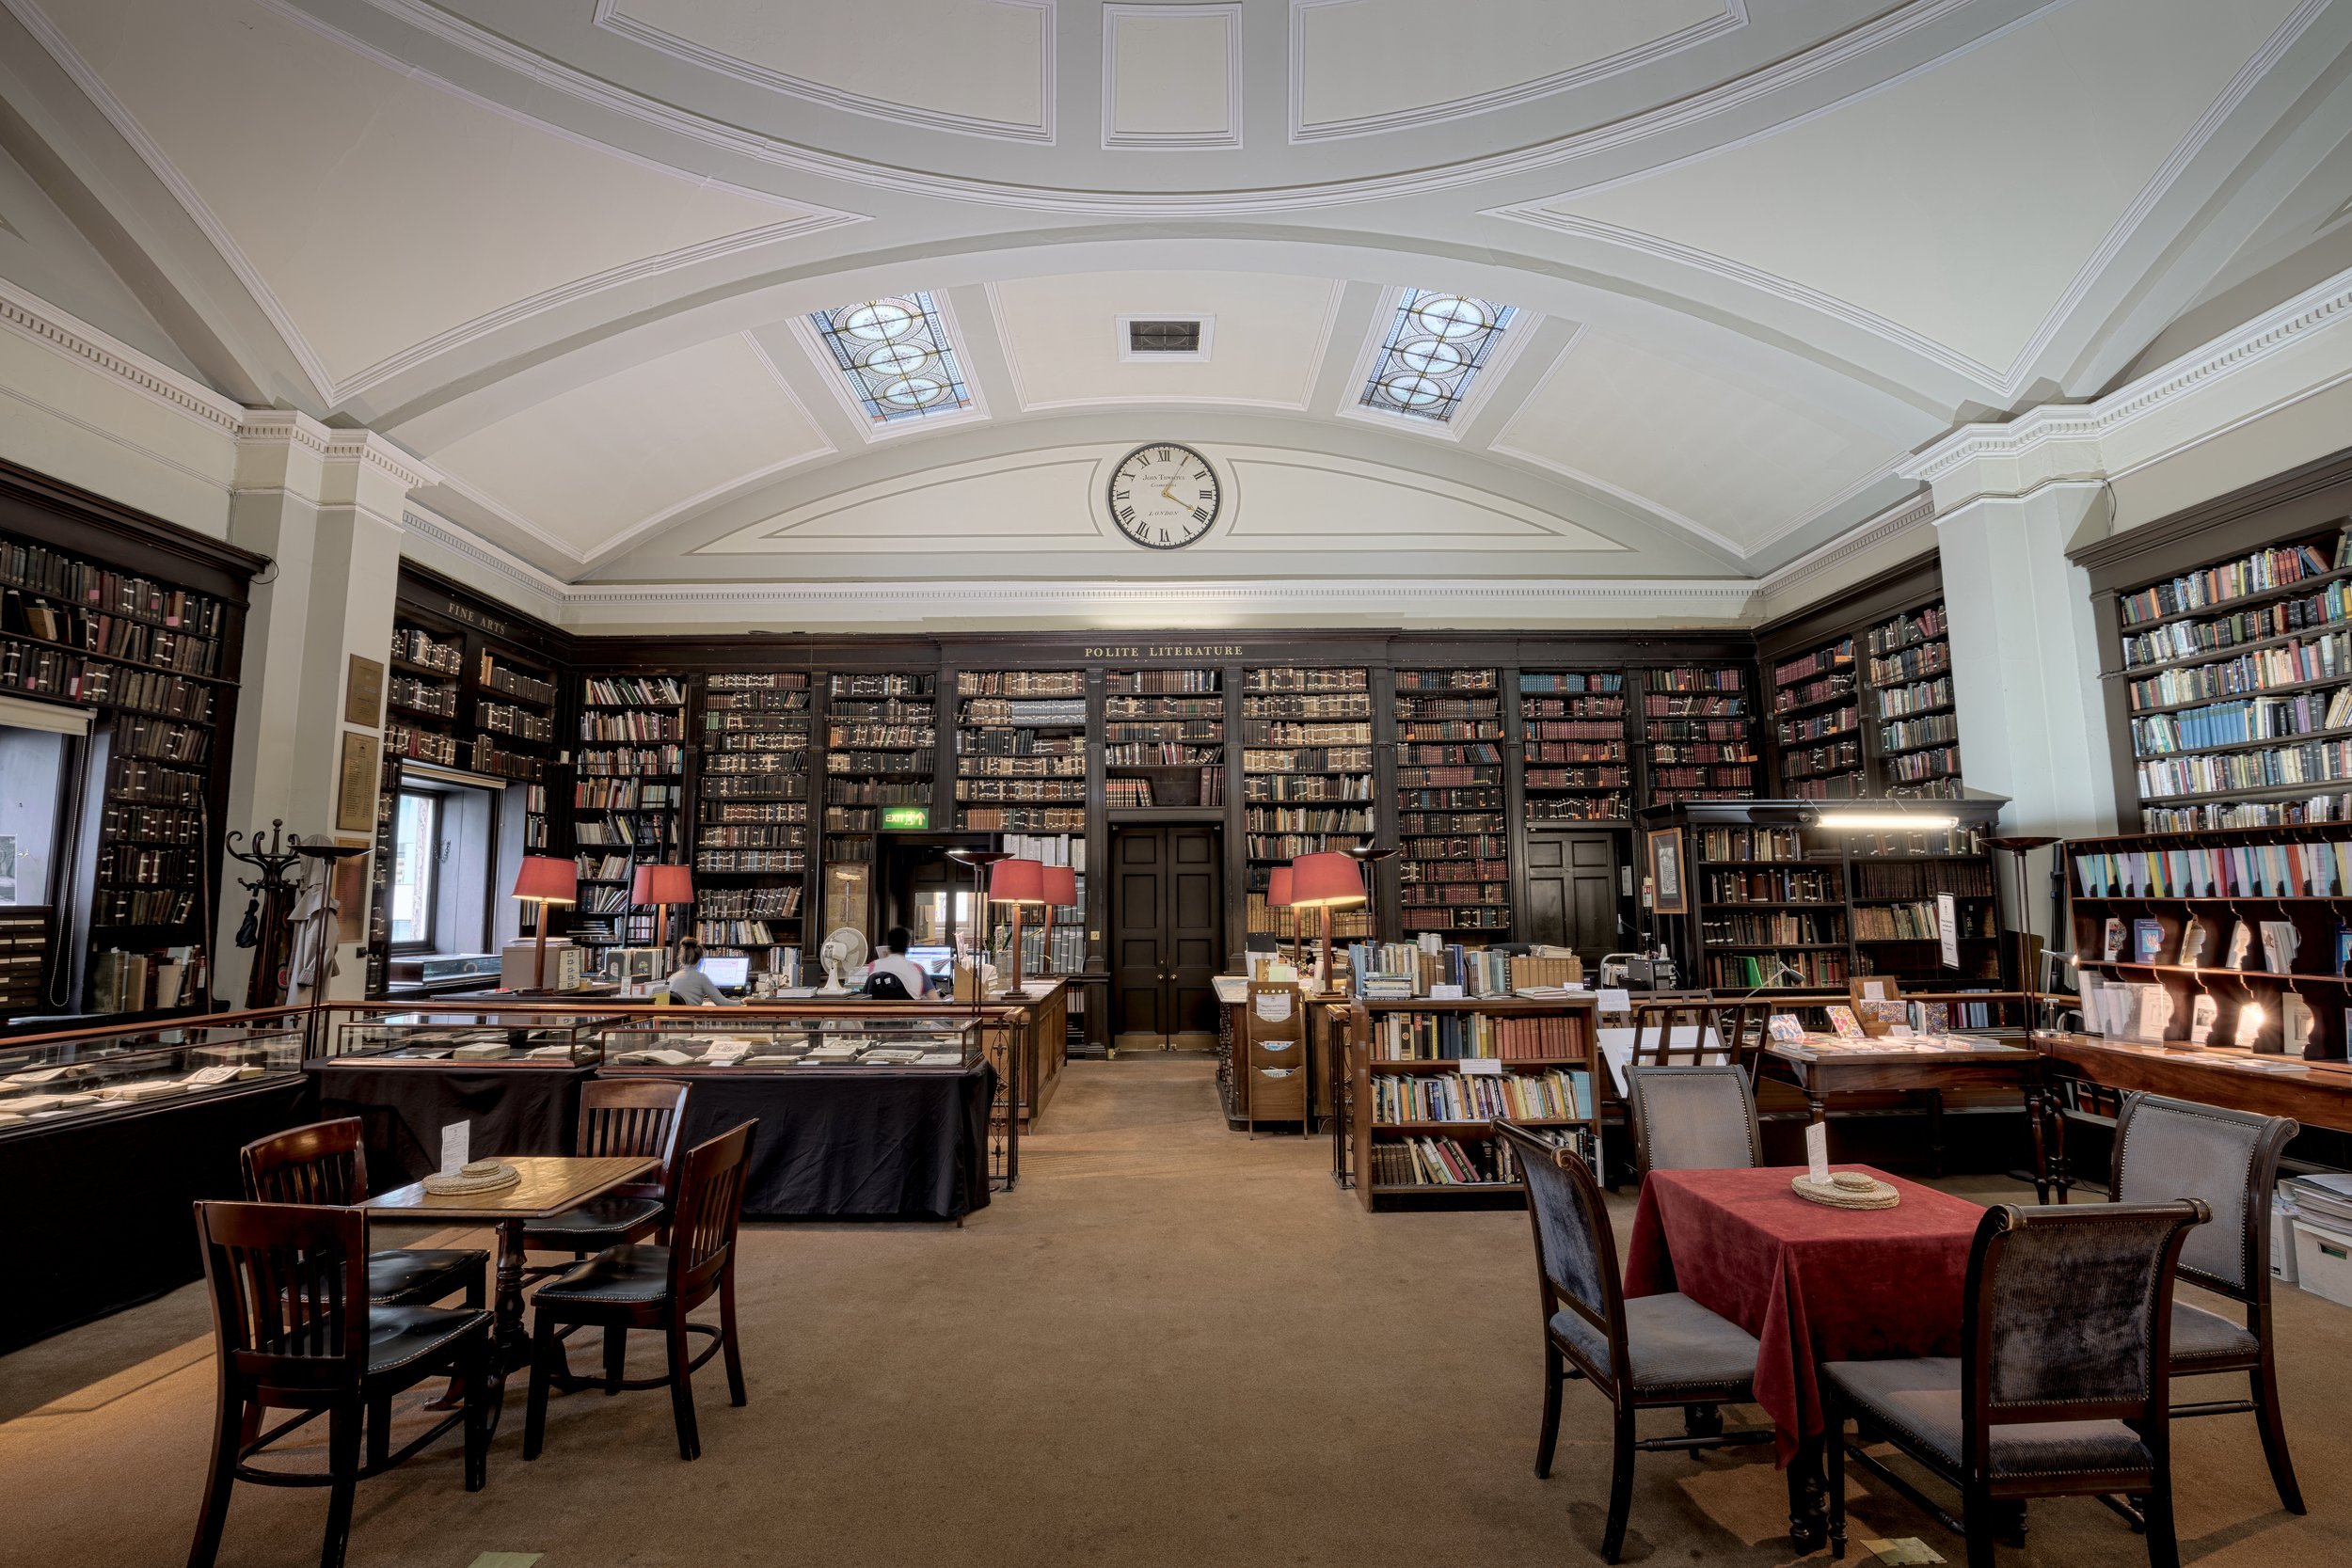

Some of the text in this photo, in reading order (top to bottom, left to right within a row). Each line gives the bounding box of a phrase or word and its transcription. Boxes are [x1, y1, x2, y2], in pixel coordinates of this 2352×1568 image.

[1157, 450, 1171, 462] XII
[1193, 470, 1207, 481] II
[1200, 489, 1213, 499] III
[1135, 520, 1151, 539] VII
[1159, 528, 1170, 542] VI
[1183, 524, 1193, 537] V
[449, 603, 505, 635] FINE ARTS
[1085, 645, 1243, 657] POLITE LITERATURE
